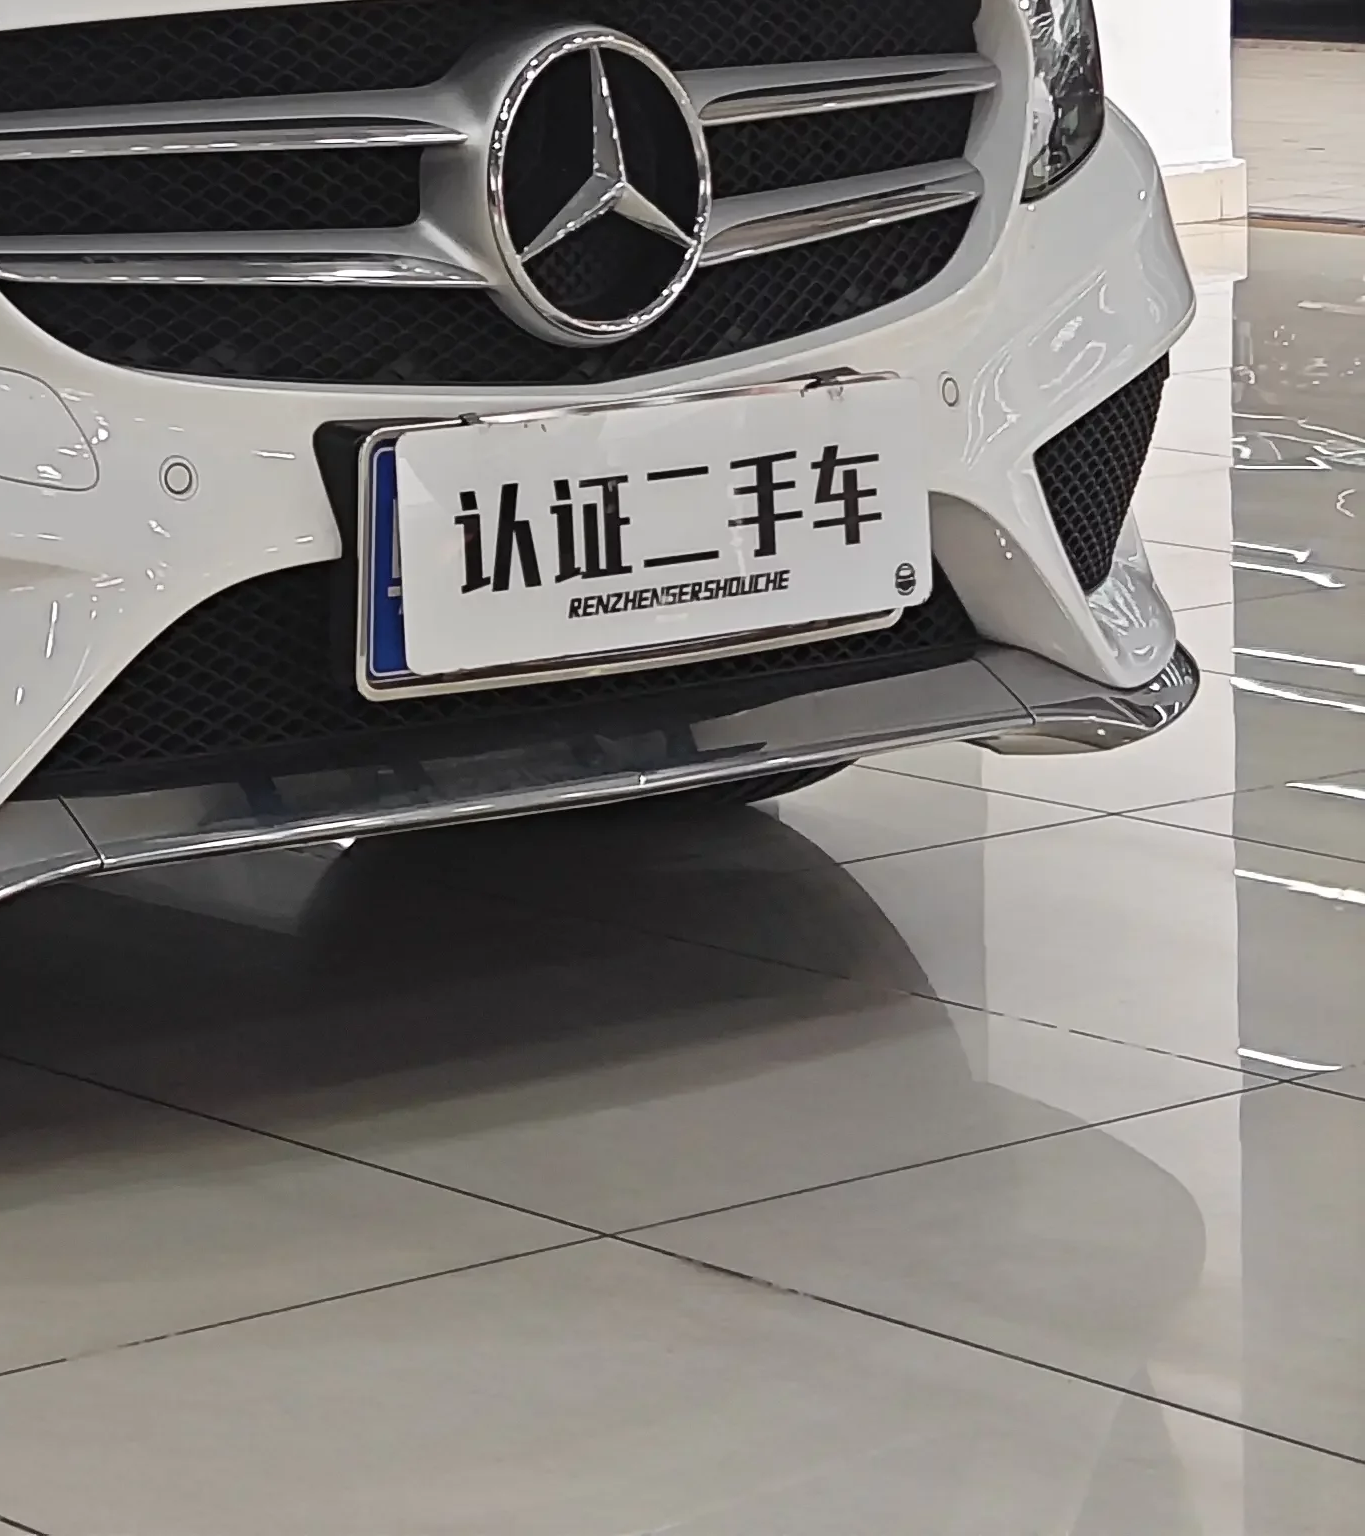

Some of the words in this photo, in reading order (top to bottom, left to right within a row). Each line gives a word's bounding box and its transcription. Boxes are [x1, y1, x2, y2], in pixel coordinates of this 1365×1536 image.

[454, 445, 882, 594] 认证二手车
